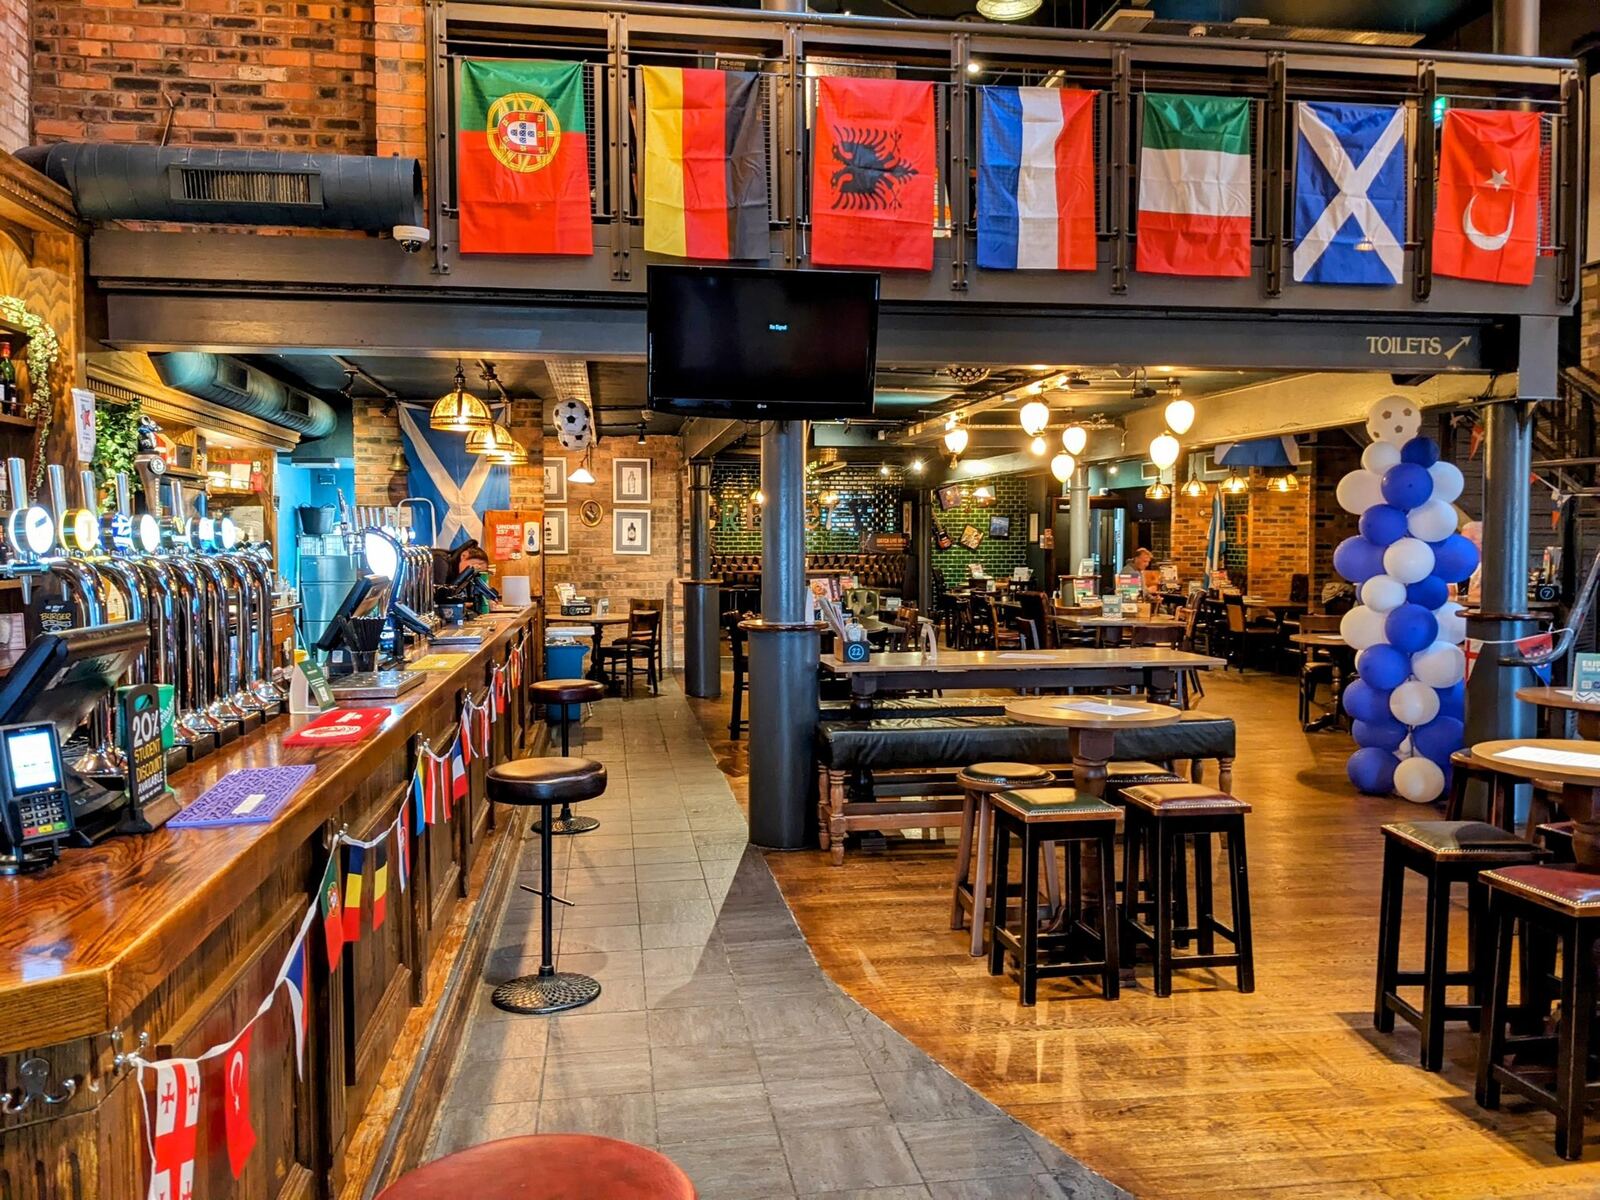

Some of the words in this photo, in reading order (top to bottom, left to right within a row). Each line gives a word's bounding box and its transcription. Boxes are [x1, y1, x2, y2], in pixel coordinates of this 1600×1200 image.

[1366, 336, 1442, 355] TOILETS
[1544, 590, 1551, 598] 7
[40, 612, 72, 620] BURGER
[852, 647, 862, 656] 22
[132, 709, 160, 748] 20%
[133, 738, 161, 764] STUDENT
[136, 755, 163, 783] DISCOUNT
[138, 771, 164, 796] AVAILABLE
